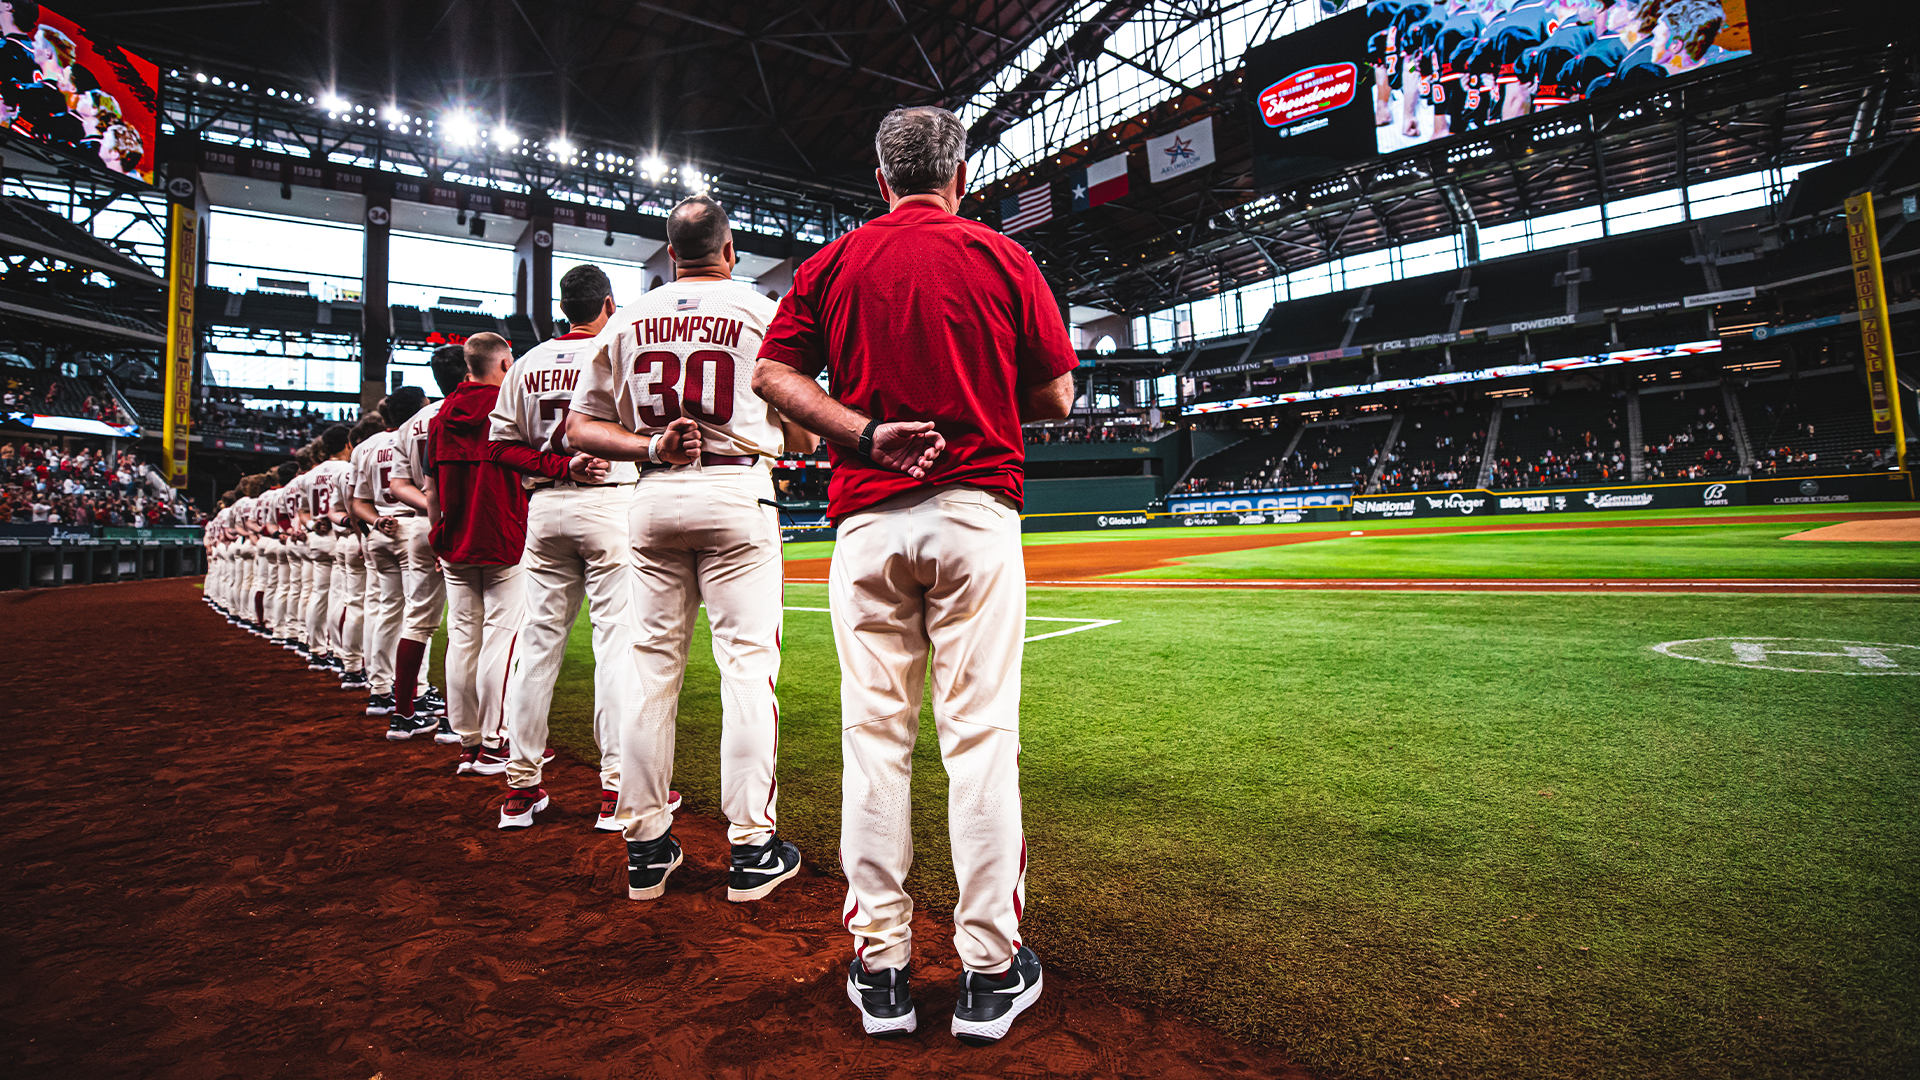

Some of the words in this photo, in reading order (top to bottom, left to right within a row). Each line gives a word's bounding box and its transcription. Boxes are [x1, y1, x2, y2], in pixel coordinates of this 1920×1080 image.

[1304, 74, 1334, 89] BASEBALL
[1266, 82, 1350, 117] Showdown
[293, 166, 322, 178] 1999
[1161, 156, 1201, 174] ARLINGTON
[336, 172, 363, 184] 2010
[171, 181, 191, 193] 42
[434, 188, 457, 199] 2011
[470, 194, 491, 205] 2011
[504, 199, 526, 211] 2012
[371, 210, 387, 221] 34
[536, 233, 550, 245] 26
[1852, 222, 1867, 261] THE
[181, 233, 194, 307] BRING
[1859, 271, 1874, 309] HOT
[1622, 306, 1639, 314] Real
[1511, 314, 1576, 332] POWERADE
[180, 314, 191, 357] THE
[632, 316, 743, 348] THOMPSON
[1383, 340, 1405, 350] PGL
[1863, 319, 1882, 371] ZONE
[1289, 354, 1309, 364] 105.3
[1196, 367, 1222, 377] LUXOR
[1223, 362, 1261, 374] STAFFING
[1496, 364, 1540, 376] GLEAMING
[176, 361, 189, 424] HEAT
[634, 350, 735, 428] 30
[312, 488, 330, 516] 13
[1444, 493, 1485, 514] Kroger
[1604, 493, 1654, 503] Germania
[1171, 499, 1252, 518] GEICO
[1257, 494, 1349, 515] GEICO
[1108, 517, 1131, 525] Globe
[1132, 516, 1147, 524] Life
[506, 799, 527, 810] NIKE
